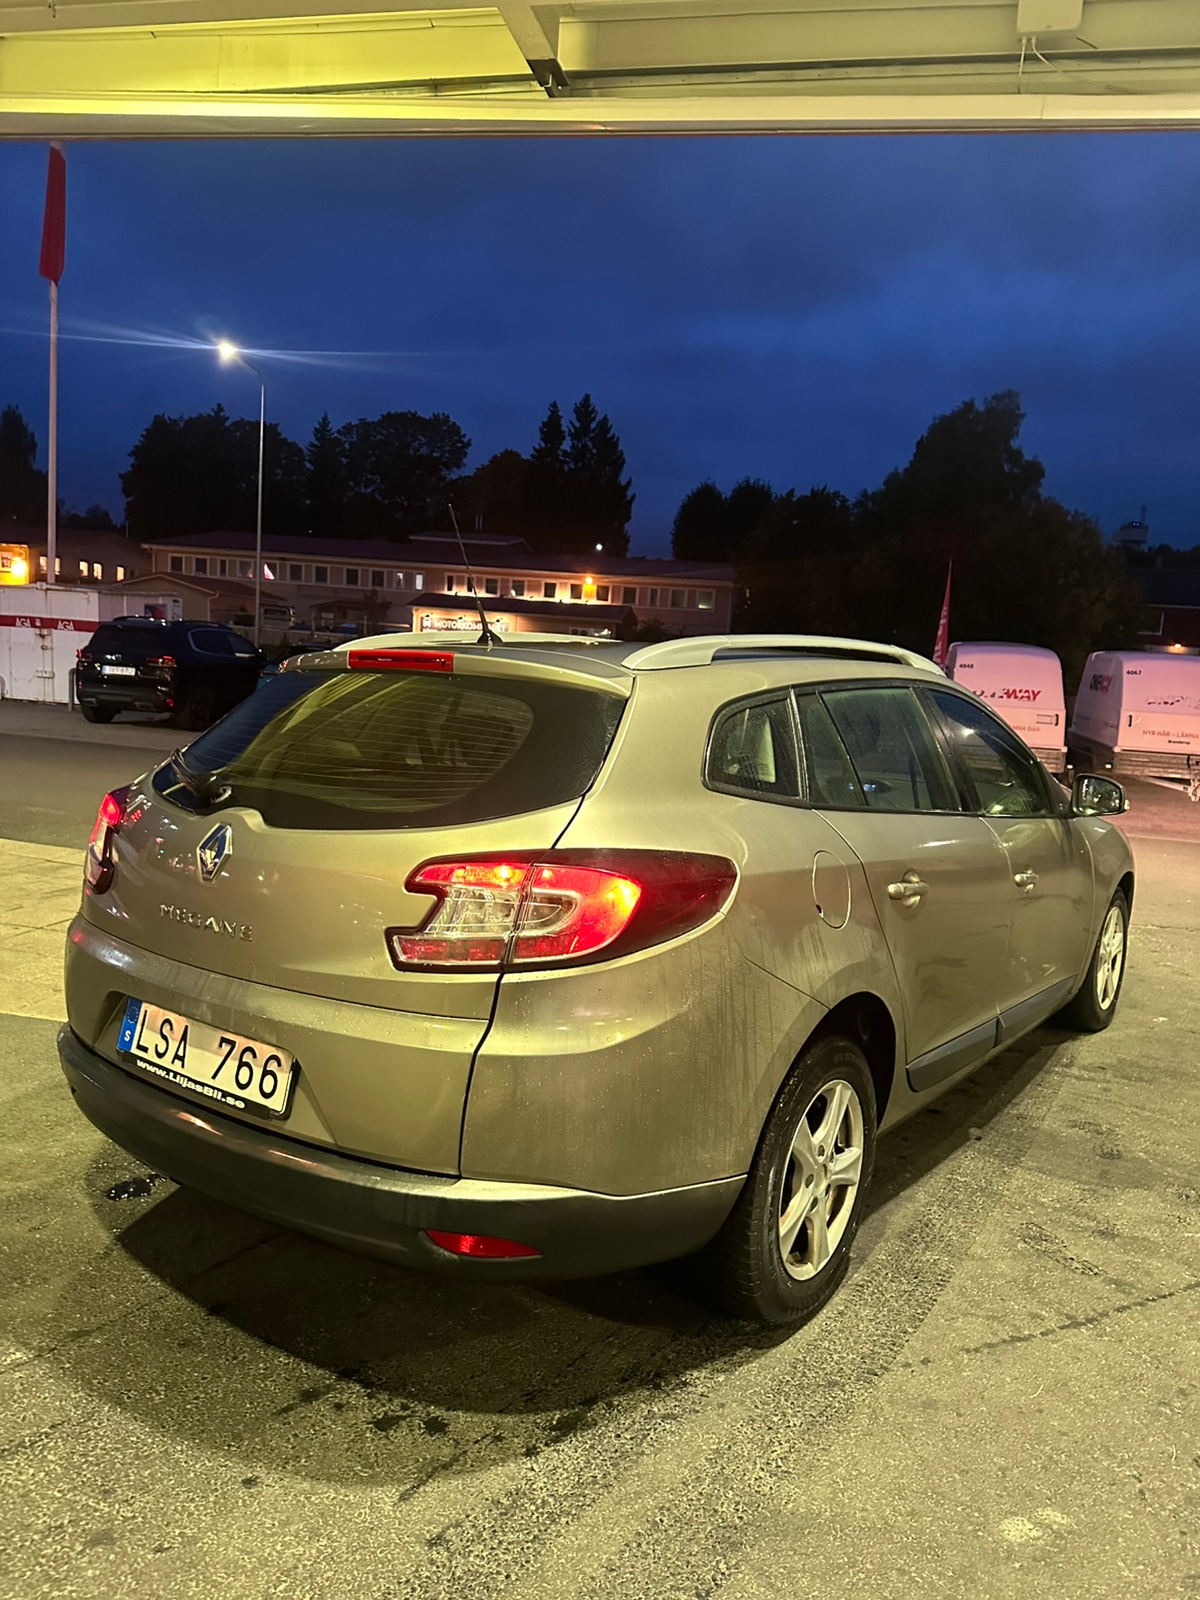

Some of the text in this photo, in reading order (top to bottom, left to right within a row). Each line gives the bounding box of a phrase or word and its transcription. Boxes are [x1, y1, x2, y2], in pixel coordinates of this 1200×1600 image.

[15, 617, 31, 628] AGA
[57, 620, 74, 631] AGA
[160, 904, 253, 942] MEGANE
[123, 1030, 132, 1042] S
[136, 1009, 283, 1099] LSA 766
[136, 1058, 246, 1109] www.LiljasBil.se
